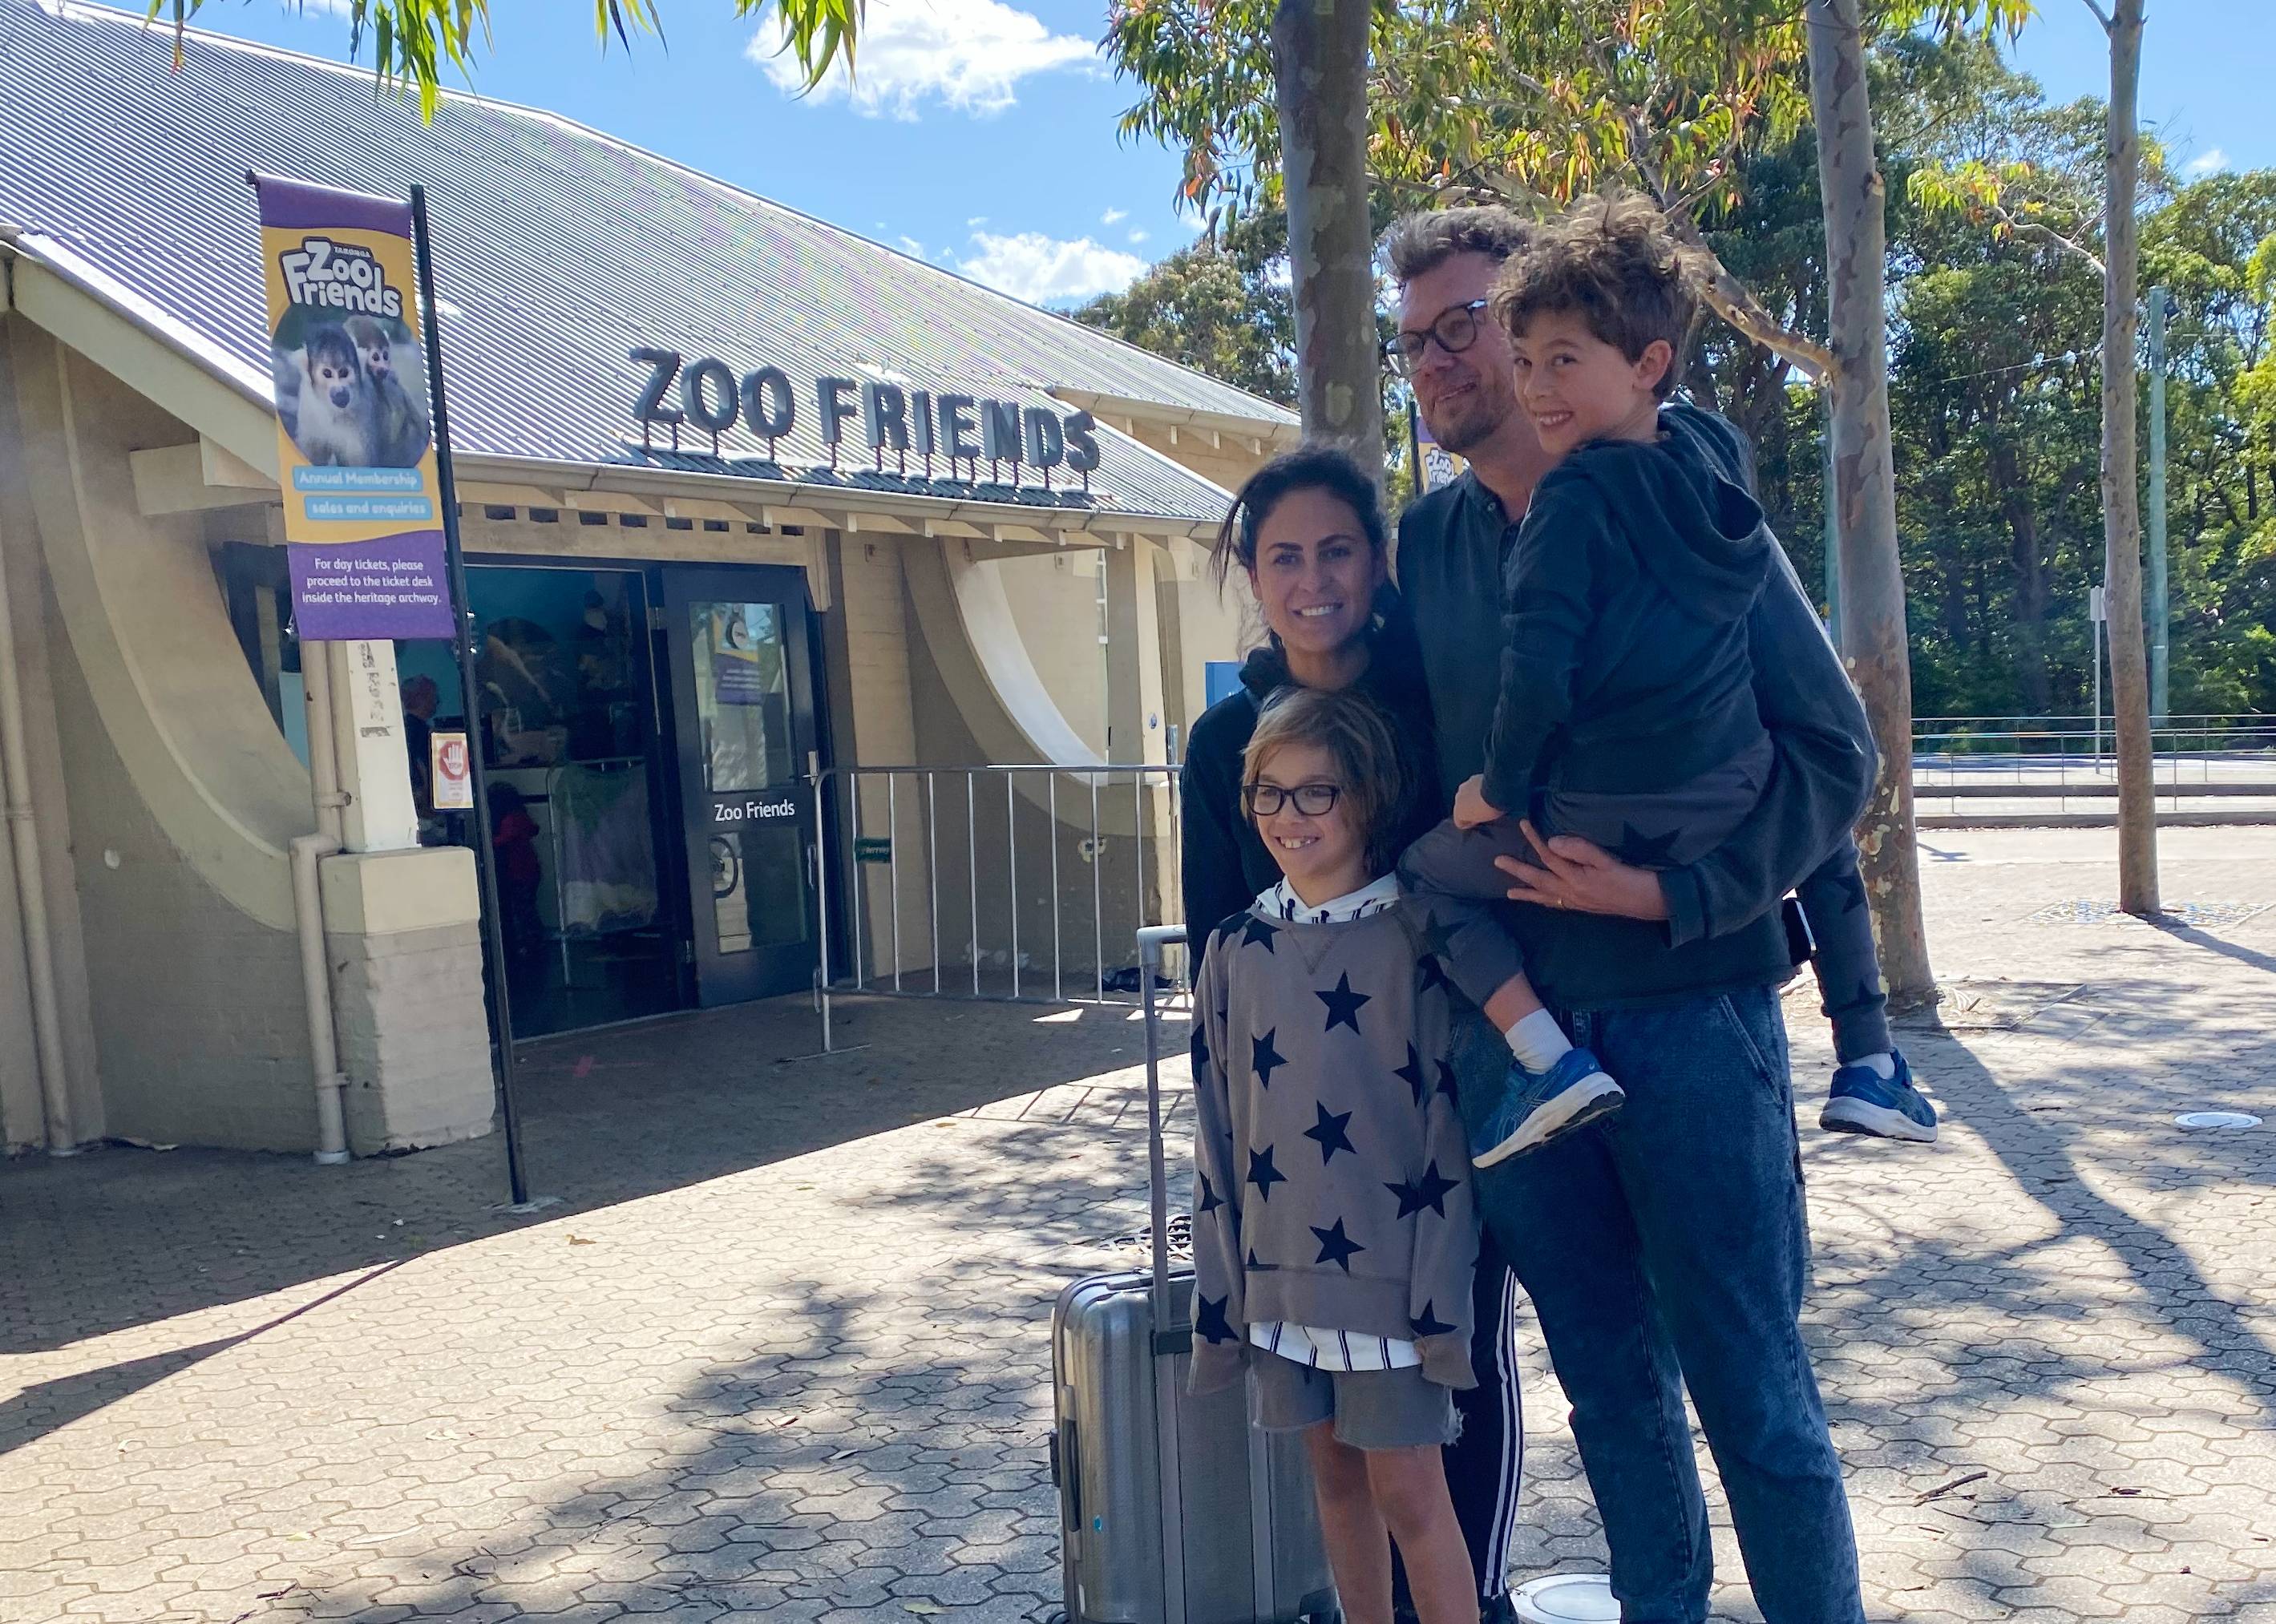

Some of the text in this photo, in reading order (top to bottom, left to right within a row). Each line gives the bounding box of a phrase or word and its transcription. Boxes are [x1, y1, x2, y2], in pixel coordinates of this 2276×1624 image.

[305, 241, 373, 288] Zoo
[281, 252, 400, 317] Friends
[629, 346, 1099, 471] ZOO FRIENDS
[300, 472, 418, 487] Annual Membership
[312, 502, 426, 516] sales and enquiries
[314, 558, 423, 572] For day tickets, please
[306, 576, 434, 588] proceed to the ticket desk
[302, 592, 442, 605] inside the heritage archway.
[714, 798, 795, 821] Zoo Friends
